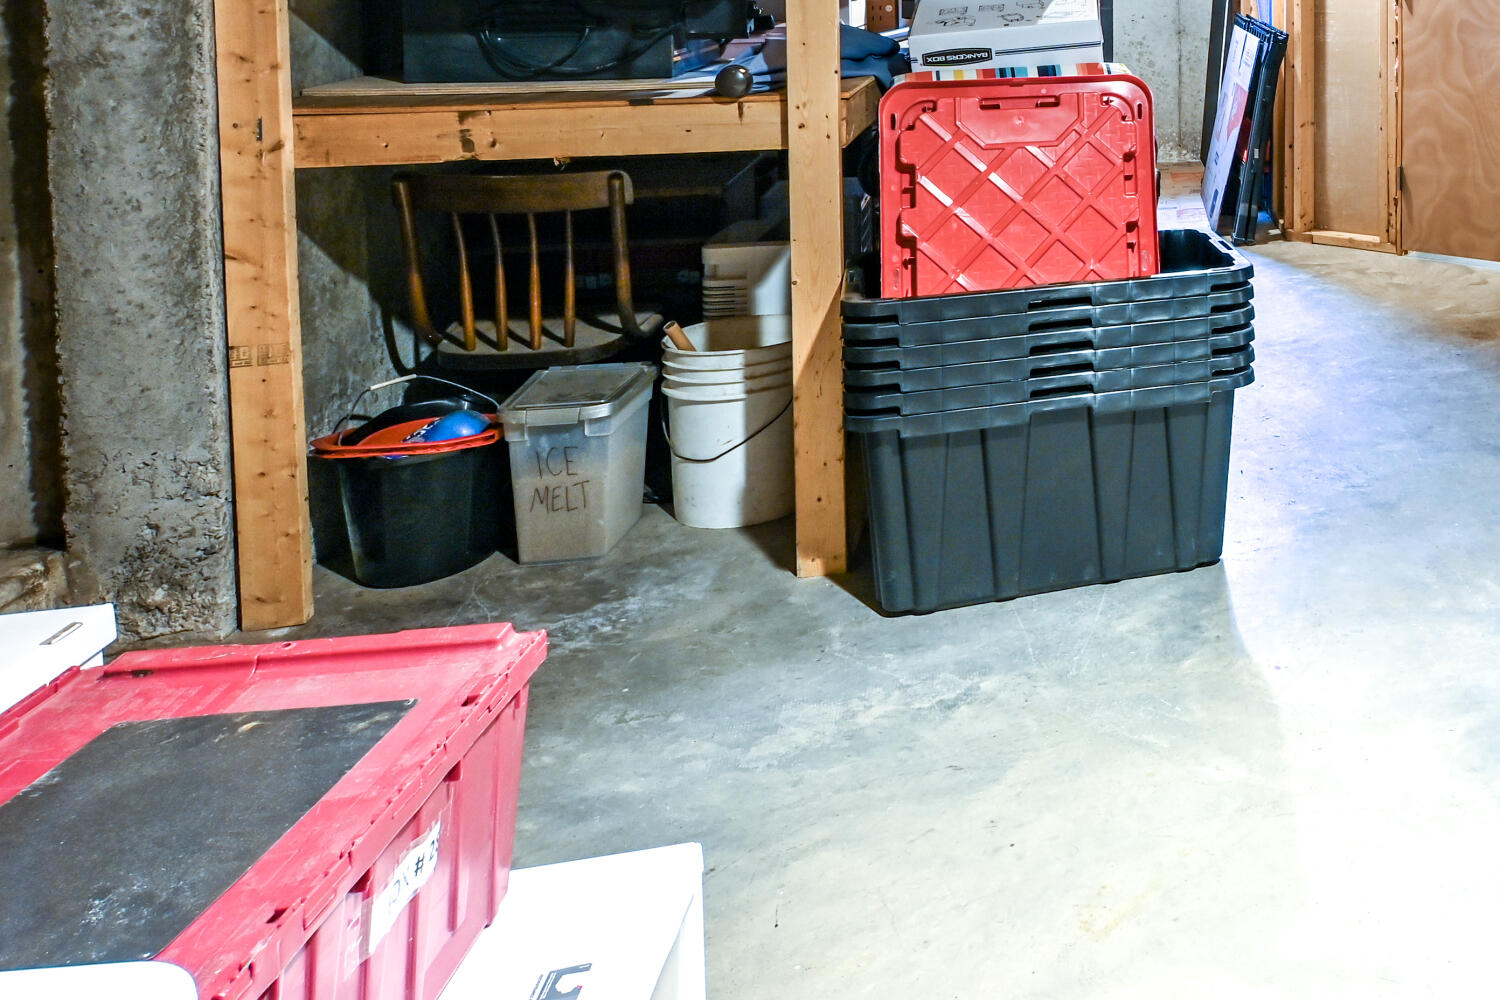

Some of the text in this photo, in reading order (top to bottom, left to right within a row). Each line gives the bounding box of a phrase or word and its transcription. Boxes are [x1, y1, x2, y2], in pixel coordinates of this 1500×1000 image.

[926, 51, 990, 63] BANKERS BOX
[535, 446, 579, 480] ICE
[529, 480, 590, 514] MELT
